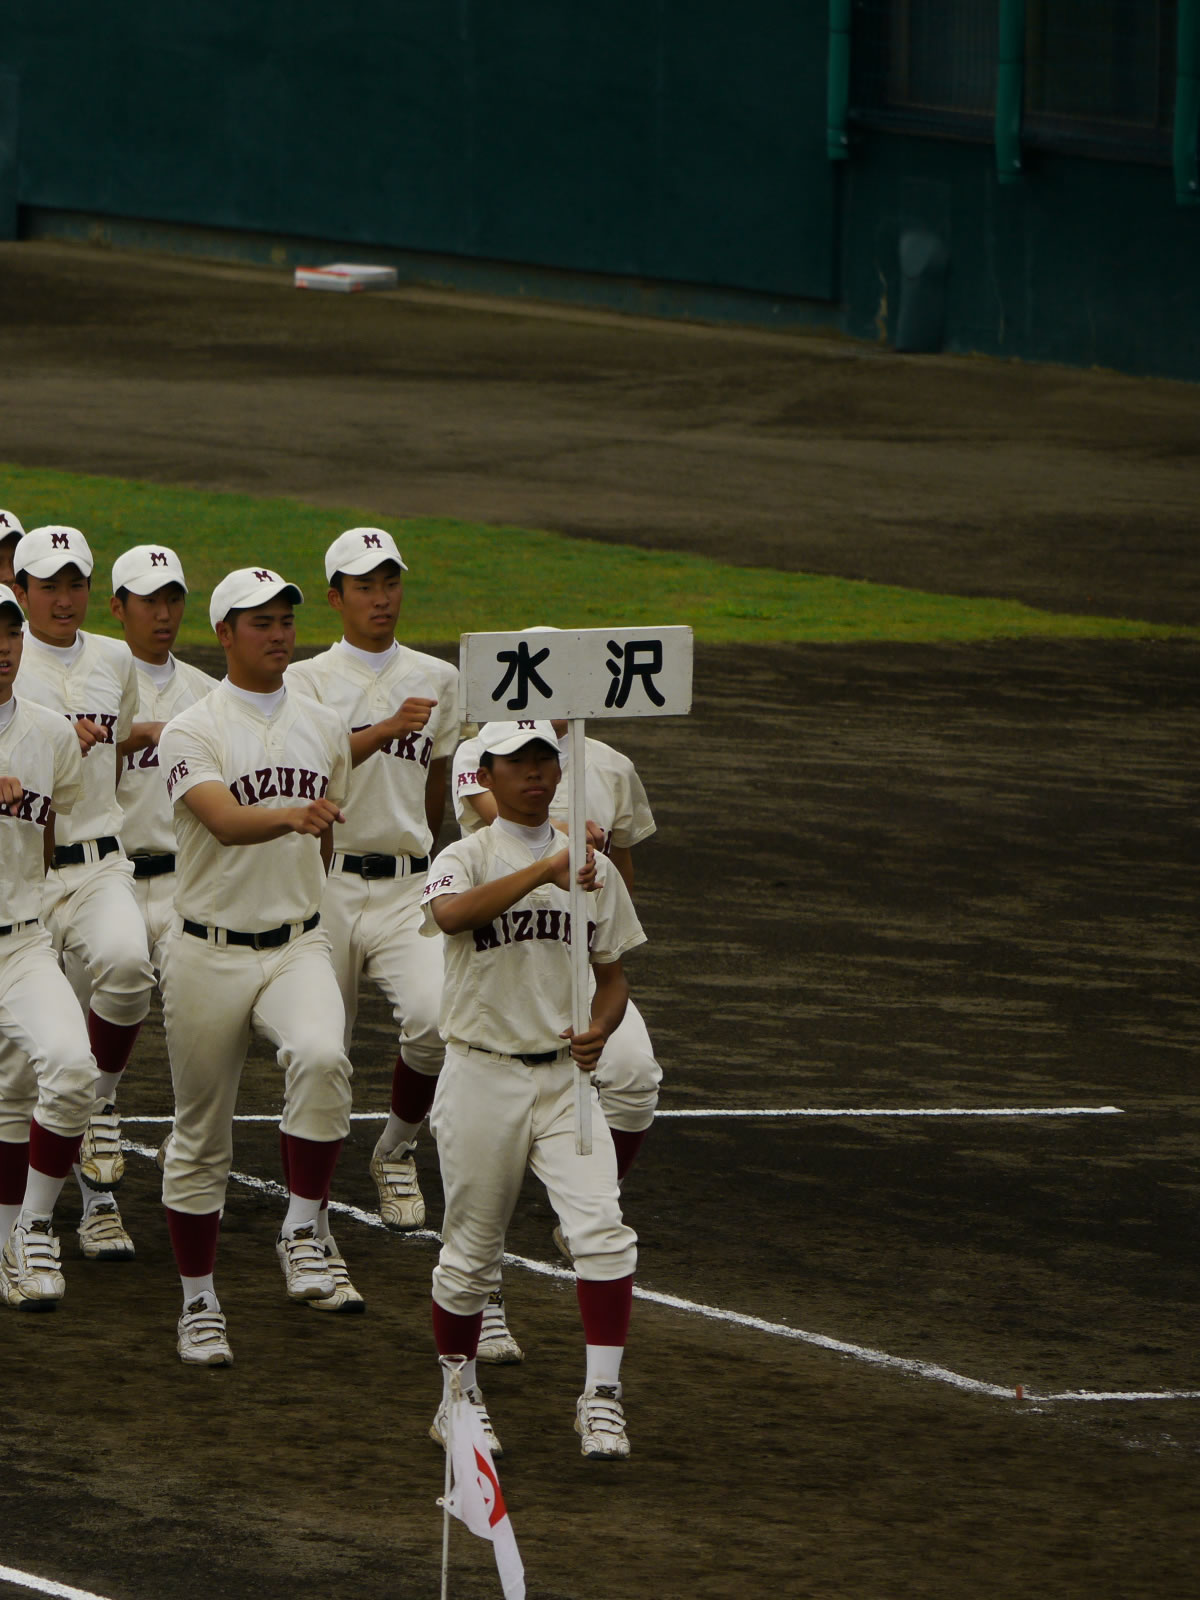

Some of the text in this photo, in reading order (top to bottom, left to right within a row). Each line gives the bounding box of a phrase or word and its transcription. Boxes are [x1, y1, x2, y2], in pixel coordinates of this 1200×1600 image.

[51, 533, 70, 549] M
[362, 534, 383, 549] M
[150, 552, 169, 567] M
[252, 570, 275, 583] M
[491, 640, 666, 711] 水沢
